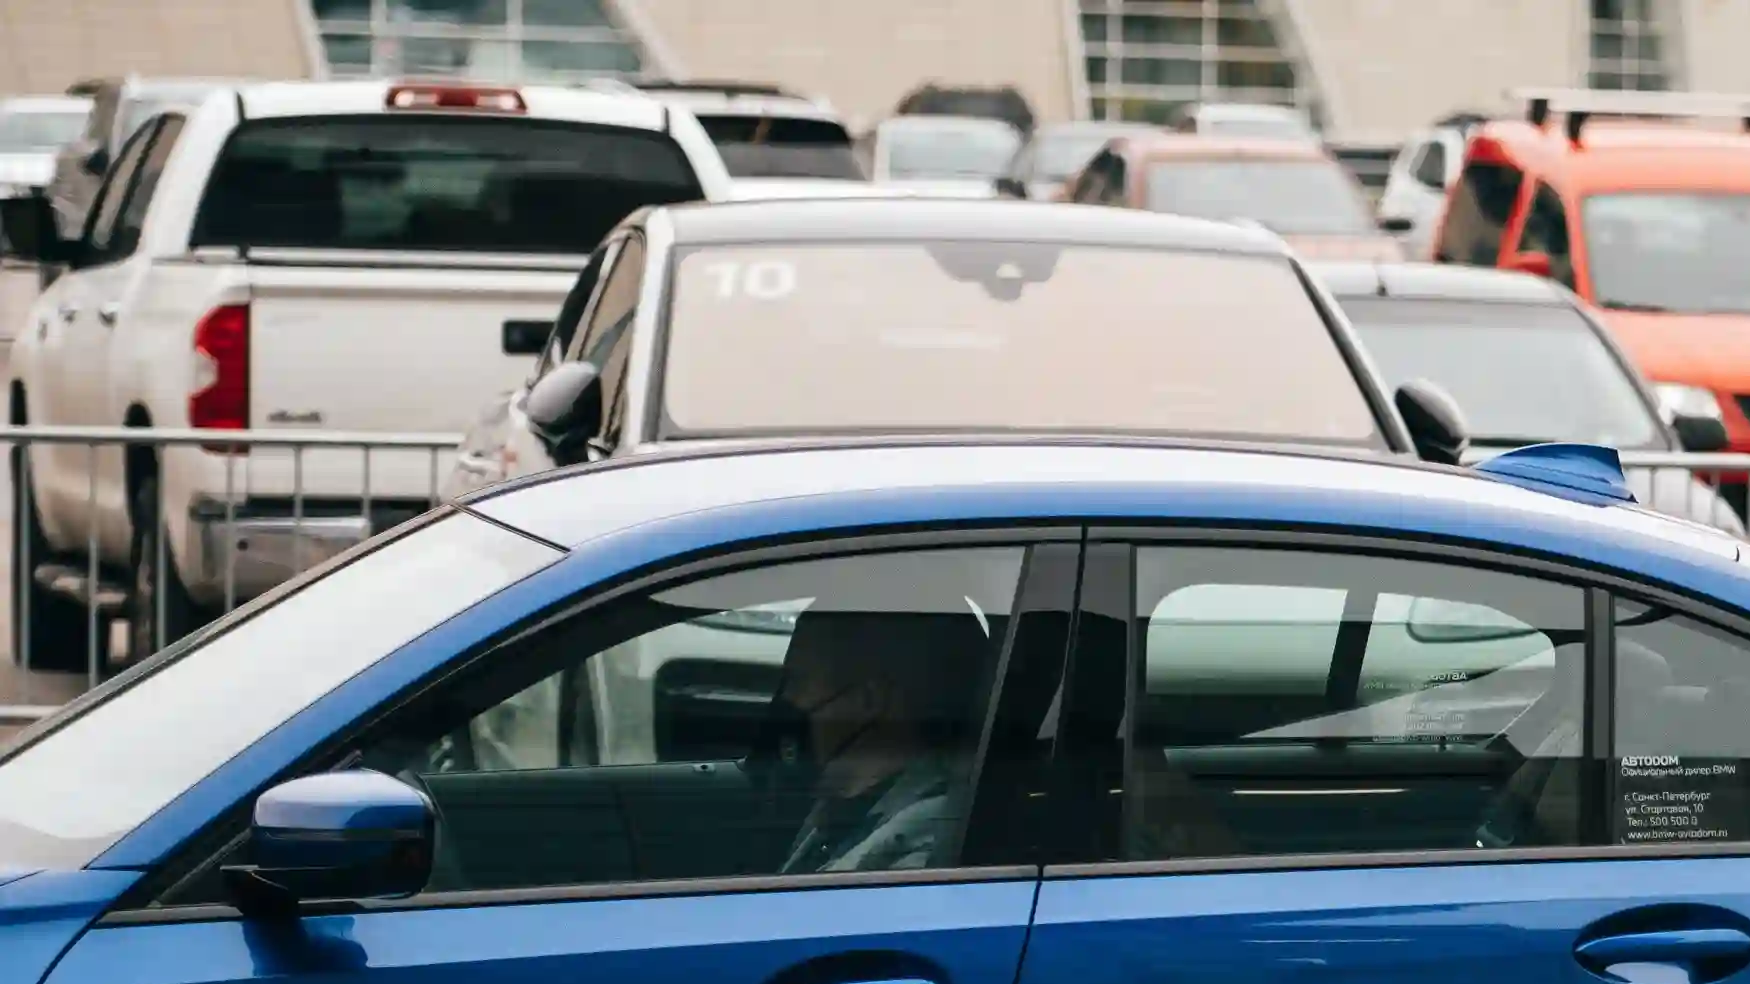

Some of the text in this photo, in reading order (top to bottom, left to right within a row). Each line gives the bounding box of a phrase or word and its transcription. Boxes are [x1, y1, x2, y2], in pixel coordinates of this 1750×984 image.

[704, 261, 797, 299] 10
[1712, 765, 1736, 775] BMW
[1632, 791, 1711, 802] Санкт-Петербург
[1649, 816, 1668, 827] 500
[1670, 816, 1689, 826] 500
